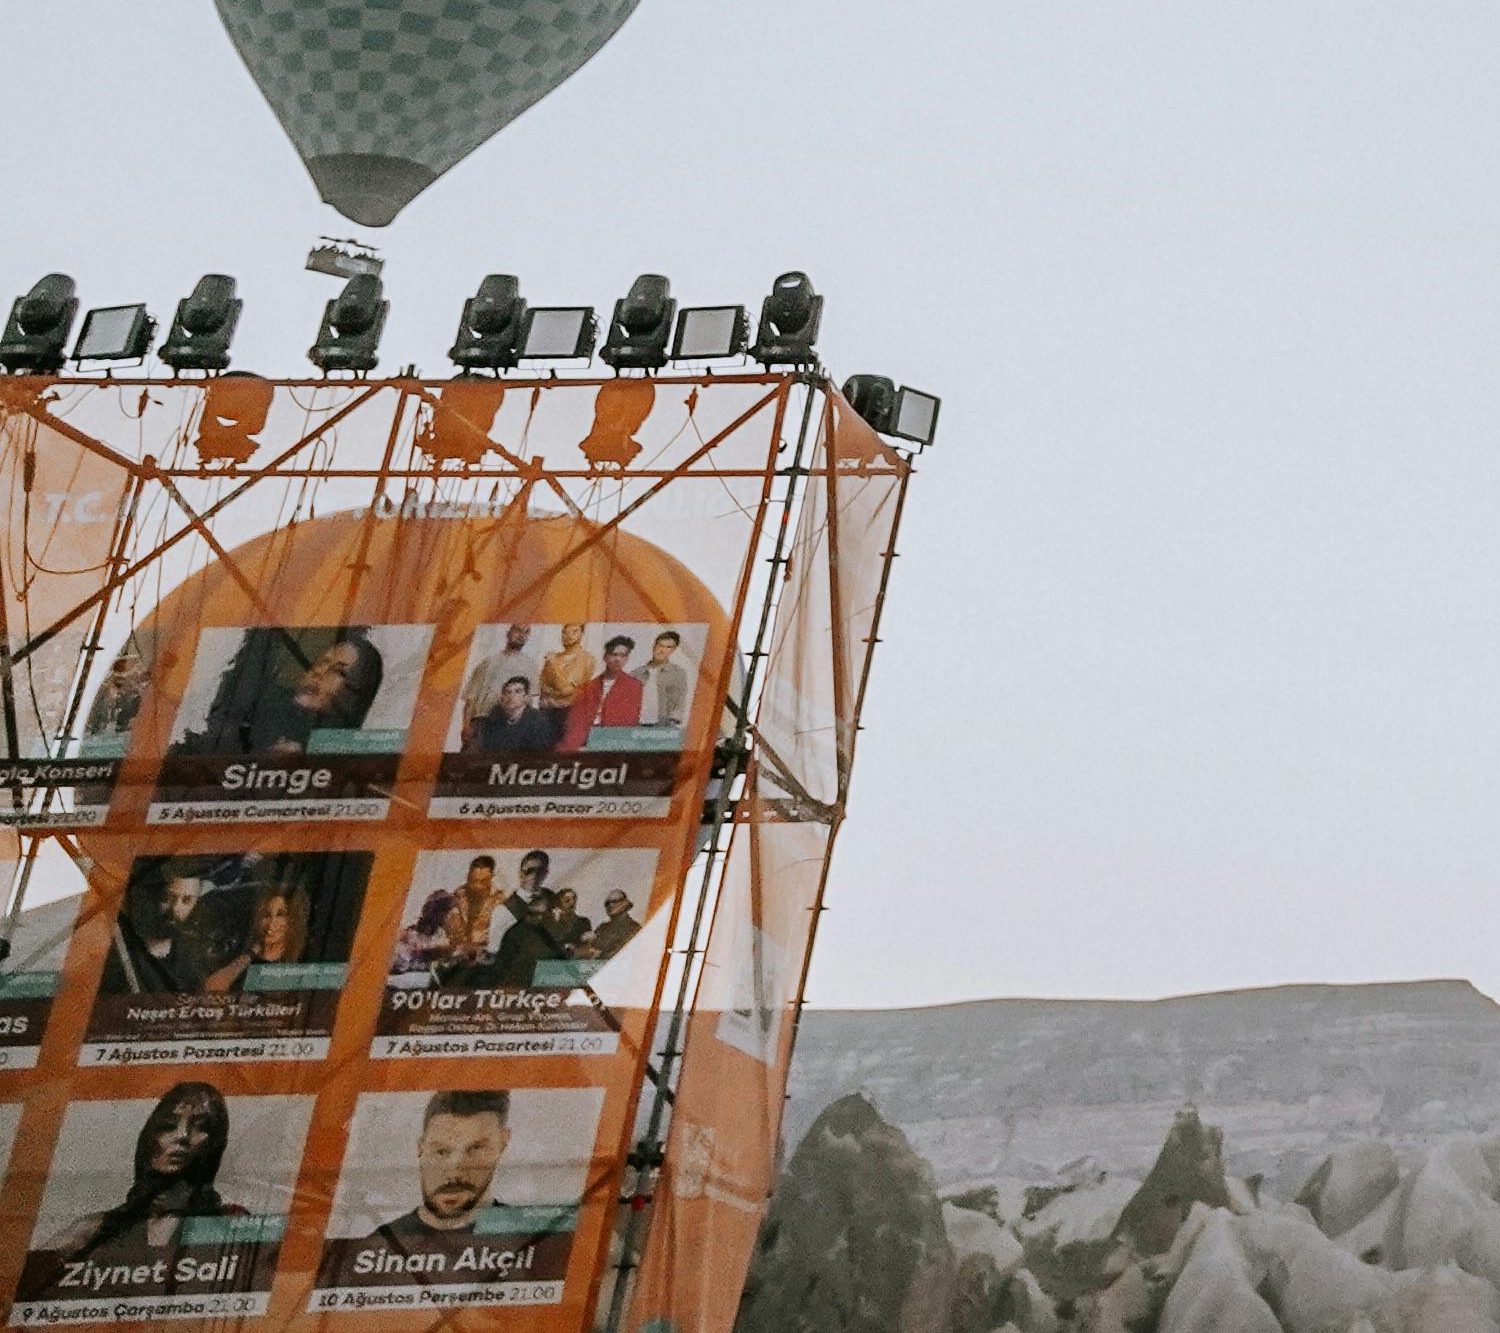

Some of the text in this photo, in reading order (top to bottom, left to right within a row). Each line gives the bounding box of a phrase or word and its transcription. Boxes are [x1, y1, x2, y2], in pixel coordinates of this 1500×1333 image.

[222, 764, 332, 793] Simge
[488, 763, 629, 789] Madrigal
[173, 806, 241, 821] Ağustos
[459, 803, 469, 814] 6
[473, 802, 541, 817] Ağustos
[544, 801, 594, 814] Pazar
[391, 989, 561, 1015] 90'lar Türkçe
[109, 1046, 179, 1063] Ağustos
[182, 1043, 266, 1059] Pazartesi
[400, 1039, 469, 1055] Ağustos
[473, 1038, 553, 1053] Pazartesi
[353, 1244, 536, 1277] Sinan Akçıl
[57, 1254, 241, 1291] Ziynet Sali
[341, 1290, 416, 1308] Ağustos
[36, 1305, 110, 1323] Ağustos
[113, 1300, 205, 1323] Çarşamba
